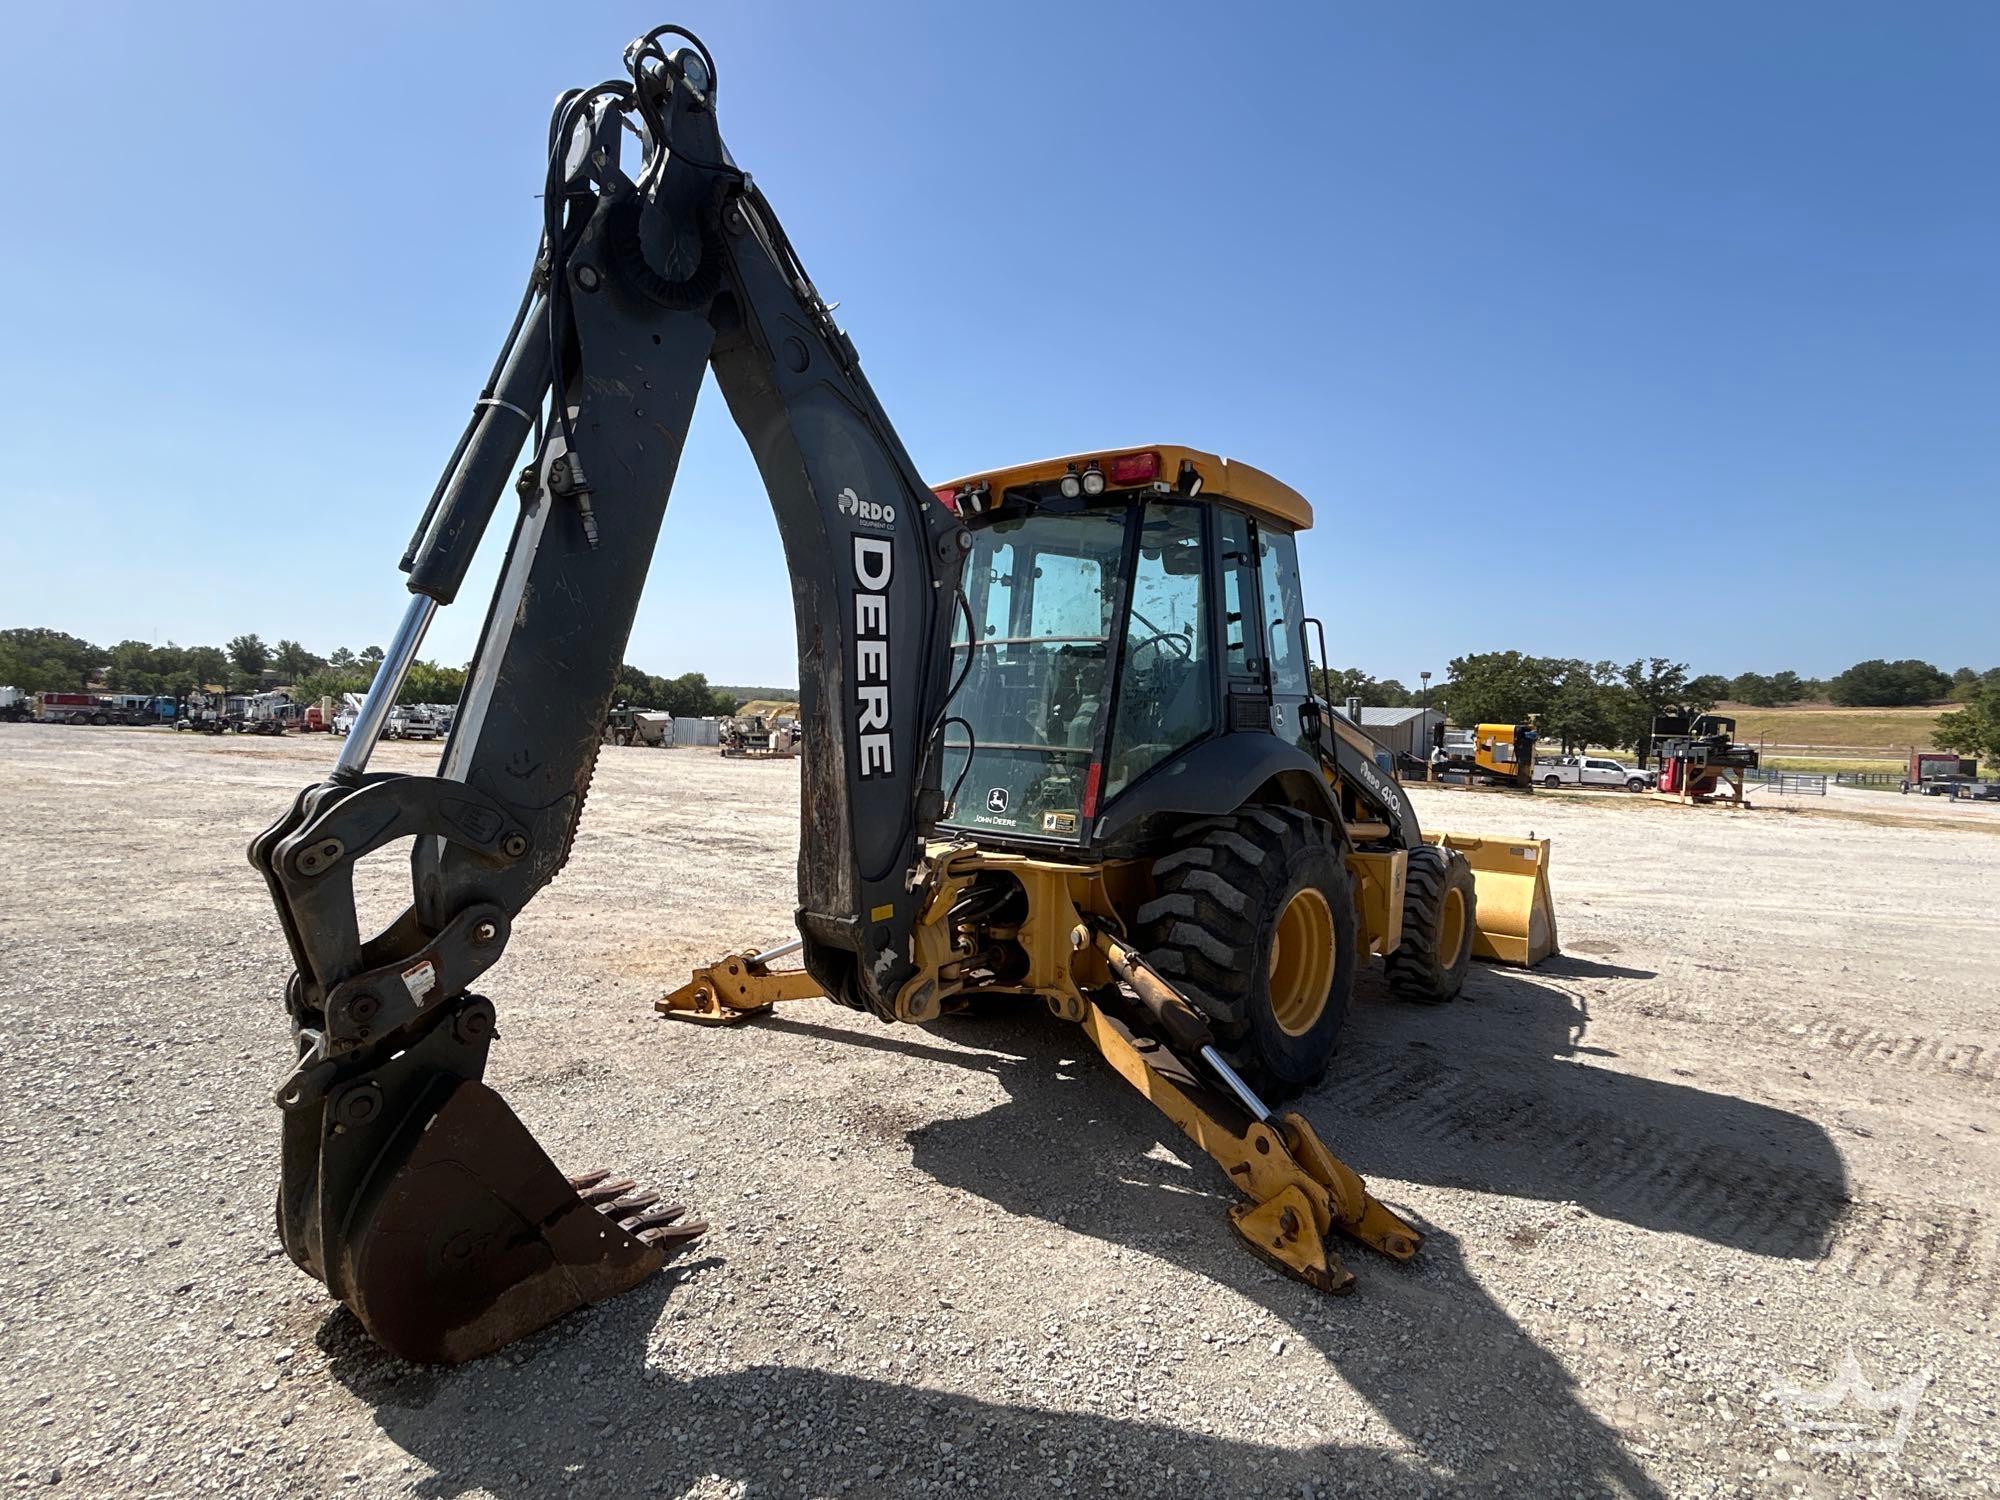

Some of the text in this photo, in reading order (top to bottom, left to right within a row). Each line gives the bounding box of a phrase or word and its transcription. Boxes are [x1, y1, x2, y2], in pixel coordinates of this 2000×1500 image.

[859, 500, 895, 523] RDO
[854, 536, 892, 775] DEERE
[1381, 786, 1402, 817] 410L
[974, 814, 1017, 827] JOHN DEERE
